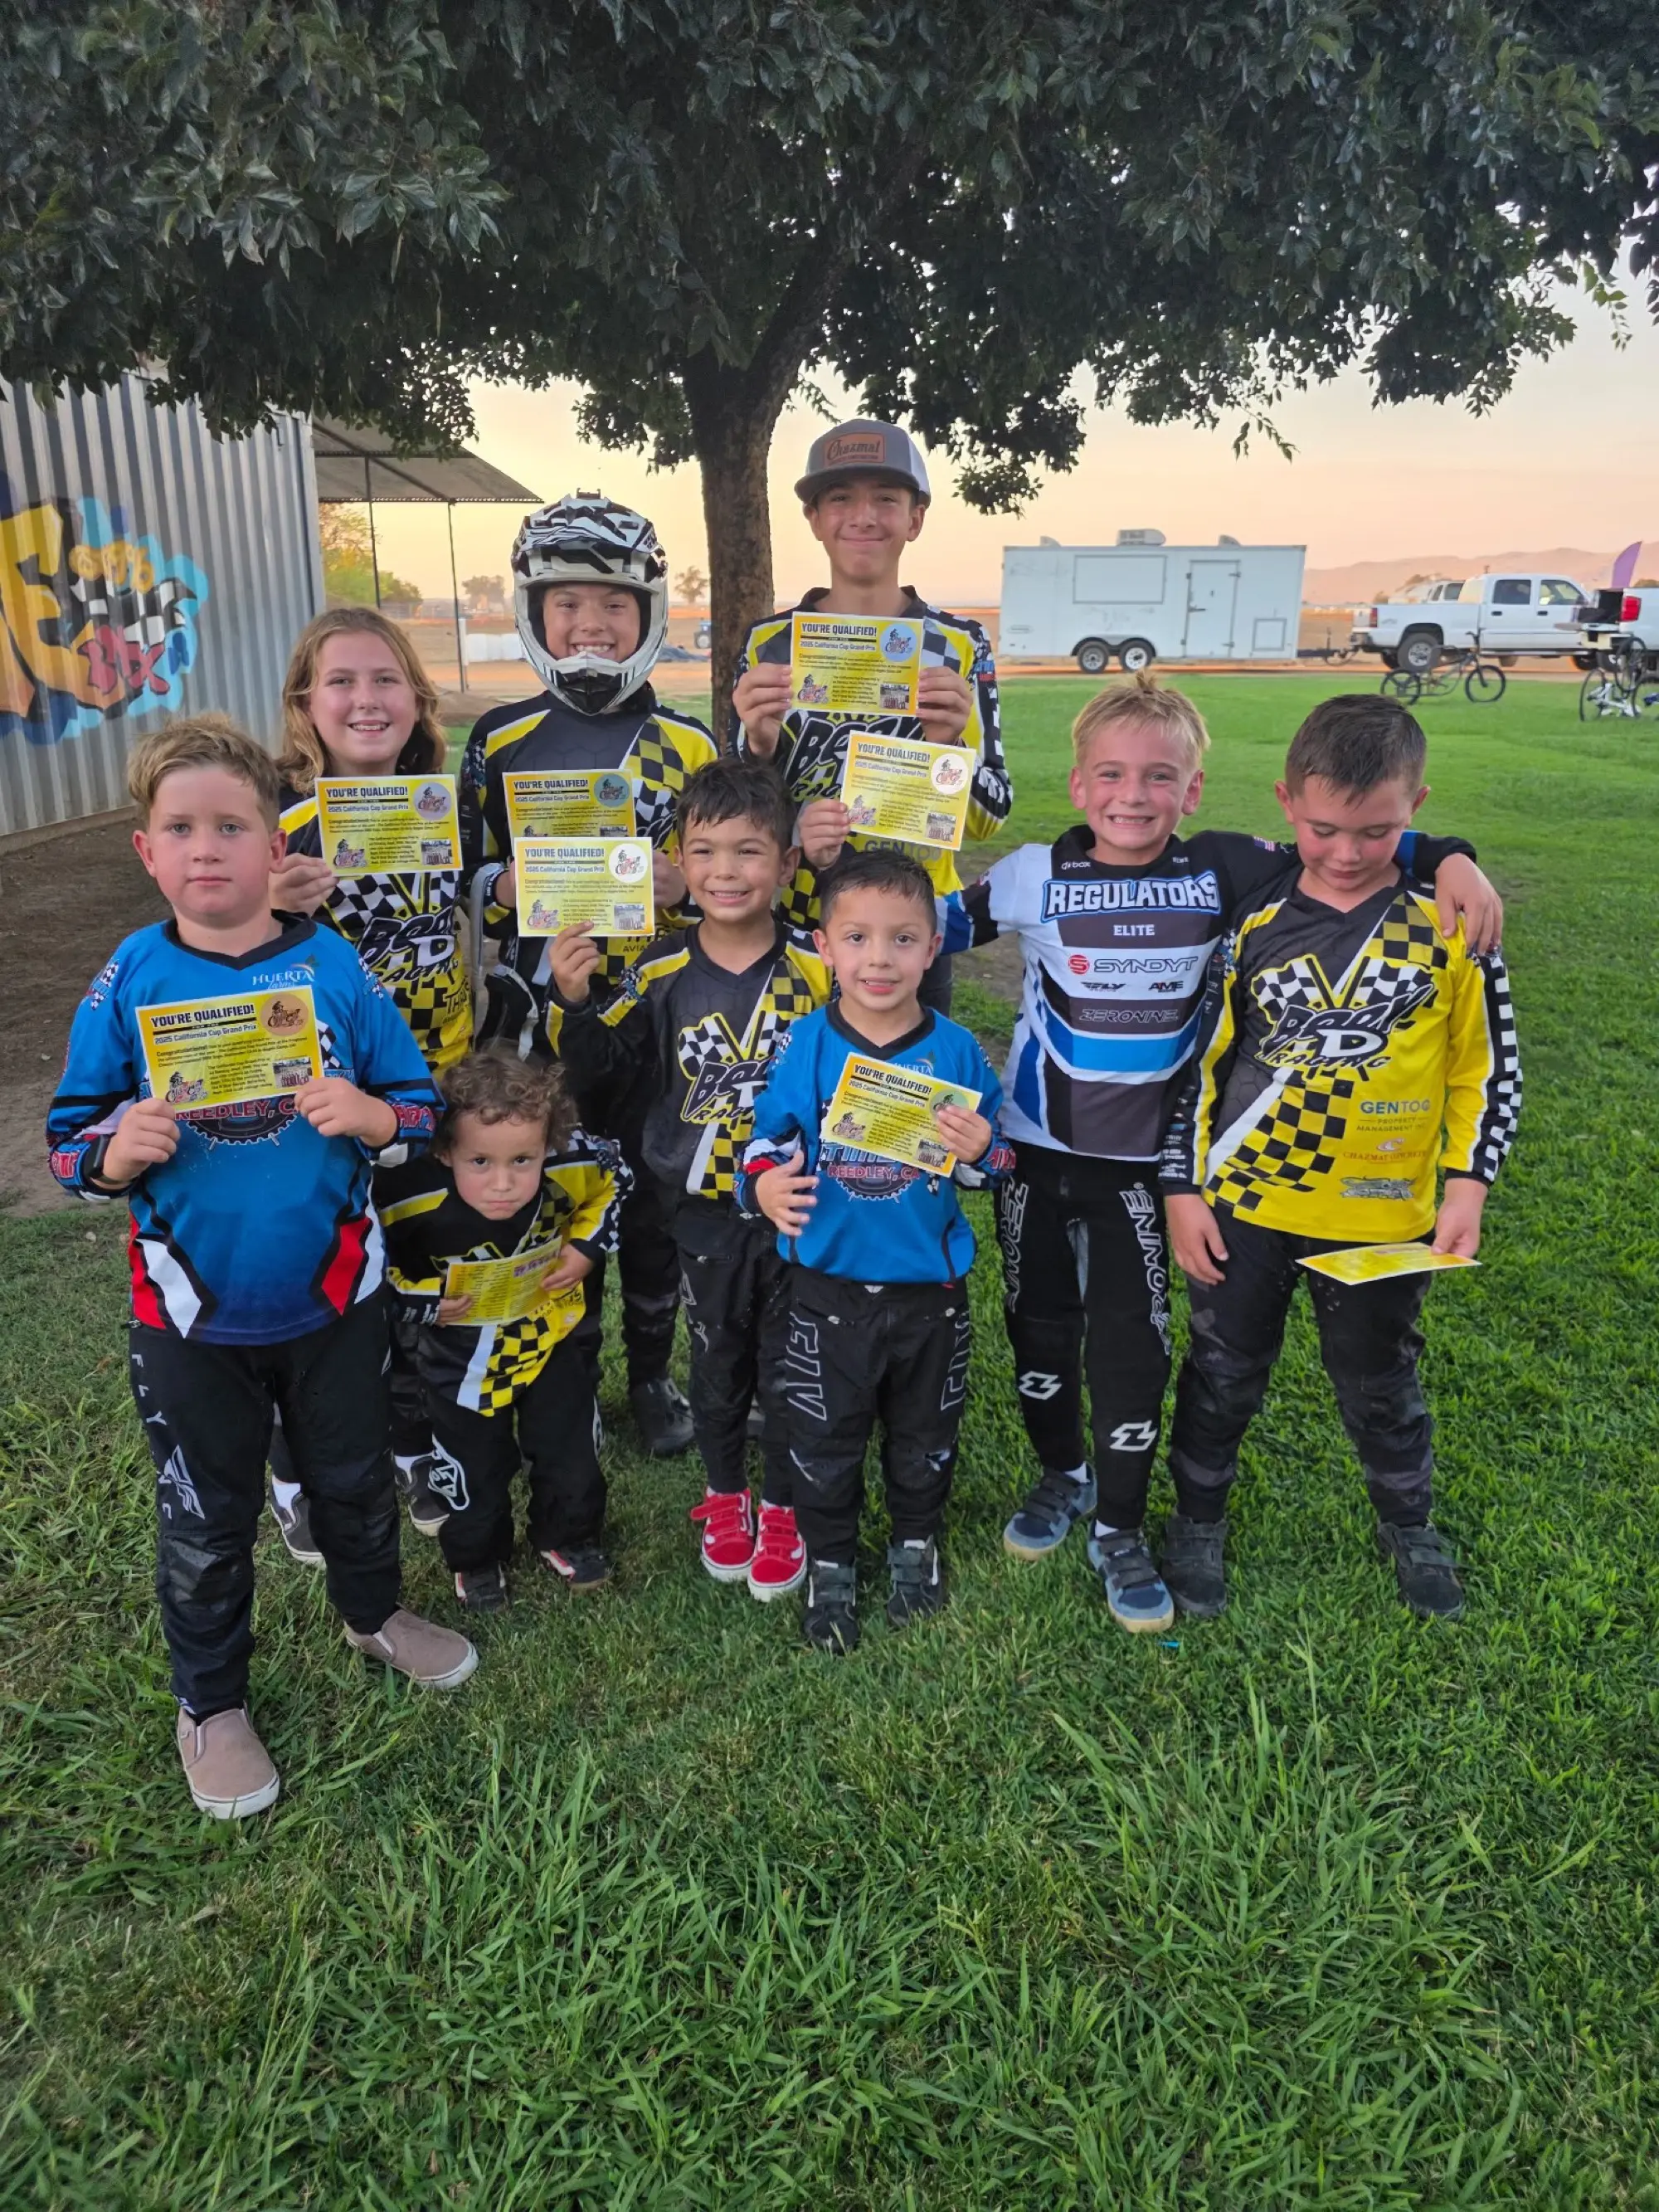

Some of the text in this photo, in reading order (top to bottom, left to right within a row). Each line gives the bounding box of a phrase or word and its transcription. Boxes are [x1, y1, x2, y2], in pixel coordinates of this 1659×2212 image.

[801, 623, 877, 637] YOU'RE QUALIFIED!
[858, 743, 931, 763] YOU'RE QUALIFIED!
[326, 787, 408, 798] YOU'RE QUALIFIED!
[513, 779, 588, 790] YOU'RE QUALIFIED!
[525, 848, 605, 859] YOU'RE QUALIFIED!
[1044, 872, 1220, 921] REGULATORS
[1113, 924, 1155, 937] ELITE
[1094, 957, 1199, 973] SYNDYT
[252, 970, 315, 986] HUERTA
[151, 1004, 255, 1028] YOU'RE QUALIFIED!
[155, 1024, 257, 1045] 2025 California Cup Grand Prix
[854, 1064, 932, 1095] YOU'RE QUALIFIED!
[278, 1097, 298, 1116] C
[827, 1166, 920, 1182] REEDLEY, CA
